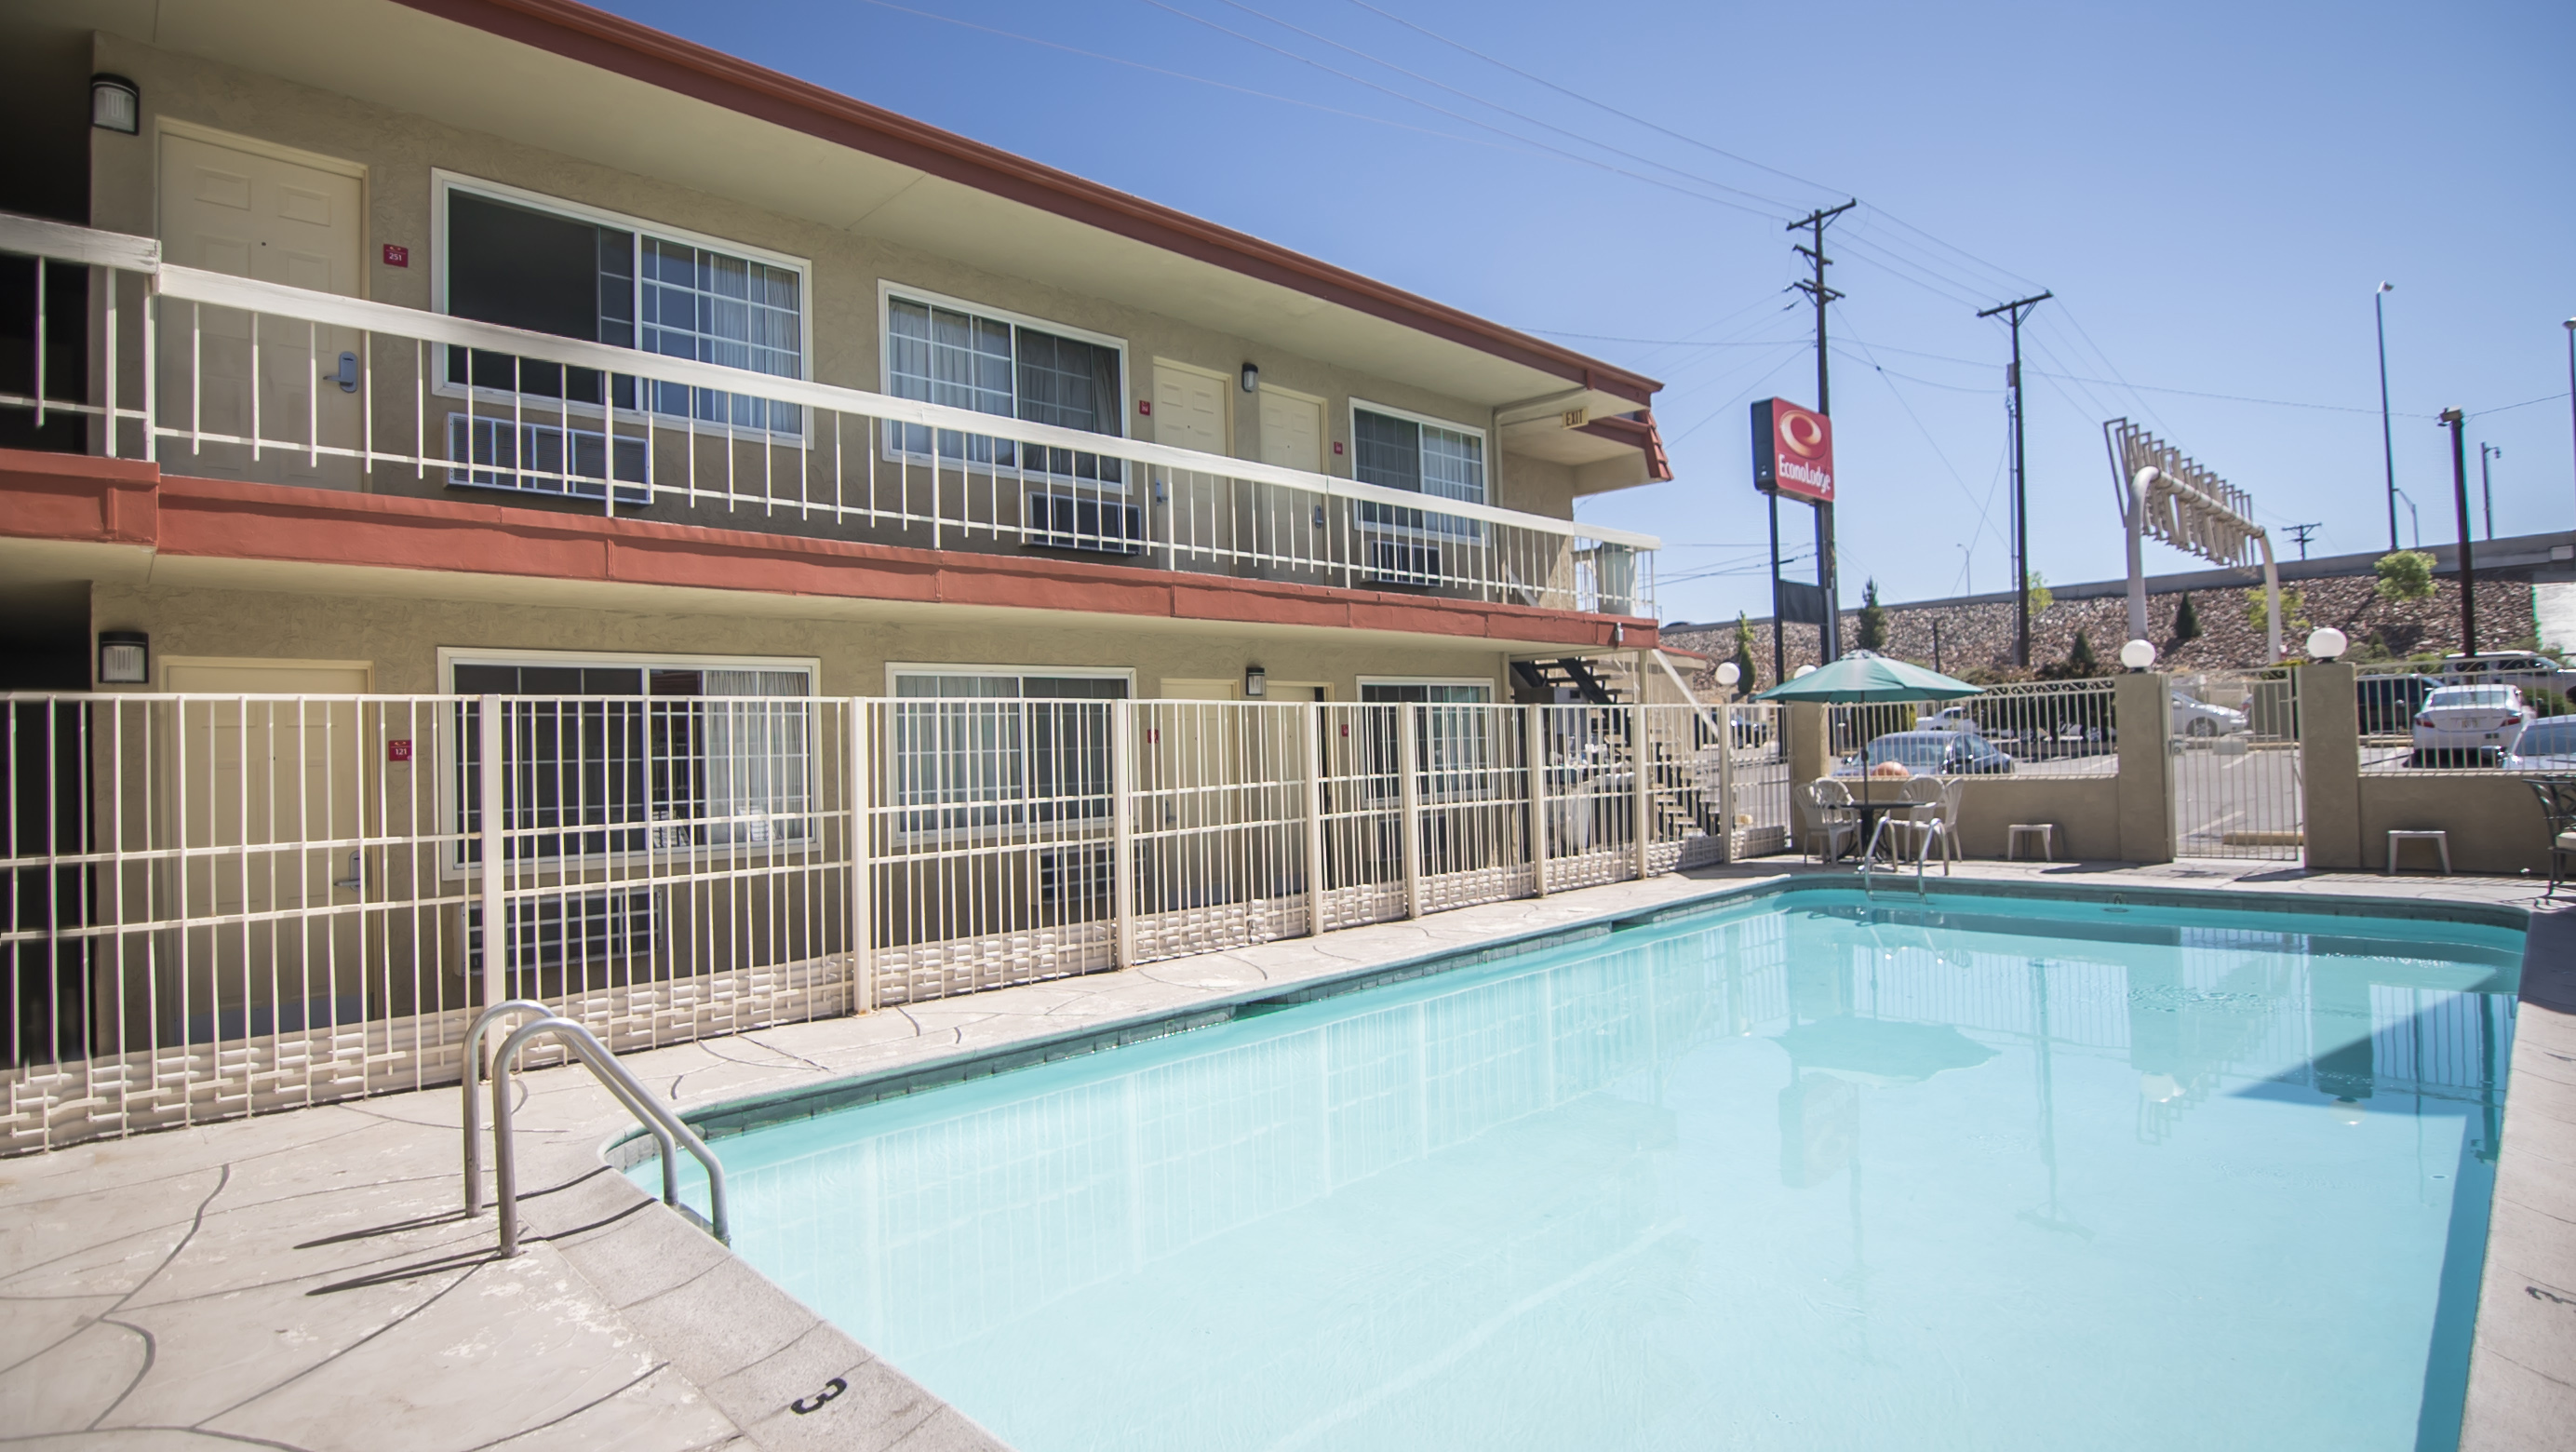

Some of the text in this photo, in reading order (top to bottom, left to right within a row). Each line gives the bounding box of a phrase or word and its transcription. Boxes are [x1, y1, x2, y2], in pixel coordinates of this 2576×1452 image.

[1565, 408, 1584, 427] EXIT
[396, 747, 408, 756] 121
[790, 1377, 848, 1415] 3
